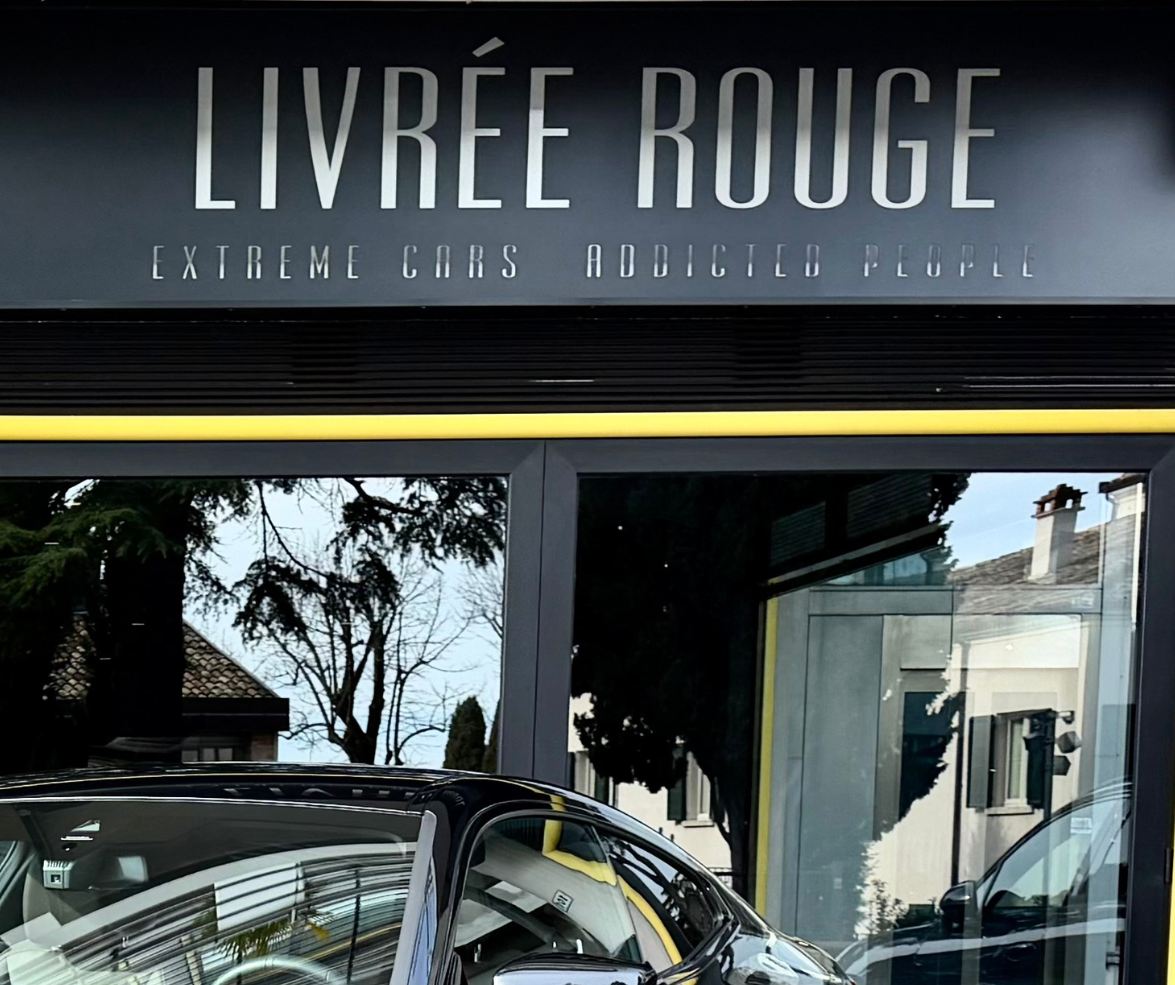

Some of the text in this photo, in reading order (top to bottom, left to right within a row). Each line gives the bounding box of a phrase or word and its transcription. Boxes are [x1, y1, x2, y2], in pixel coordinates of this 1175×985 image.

[194, 37, 1002, 210] LIVRÉE ROUGE
[152, 243, 1036, 280] EXTREME CARS ADDICTED PEOPLE
